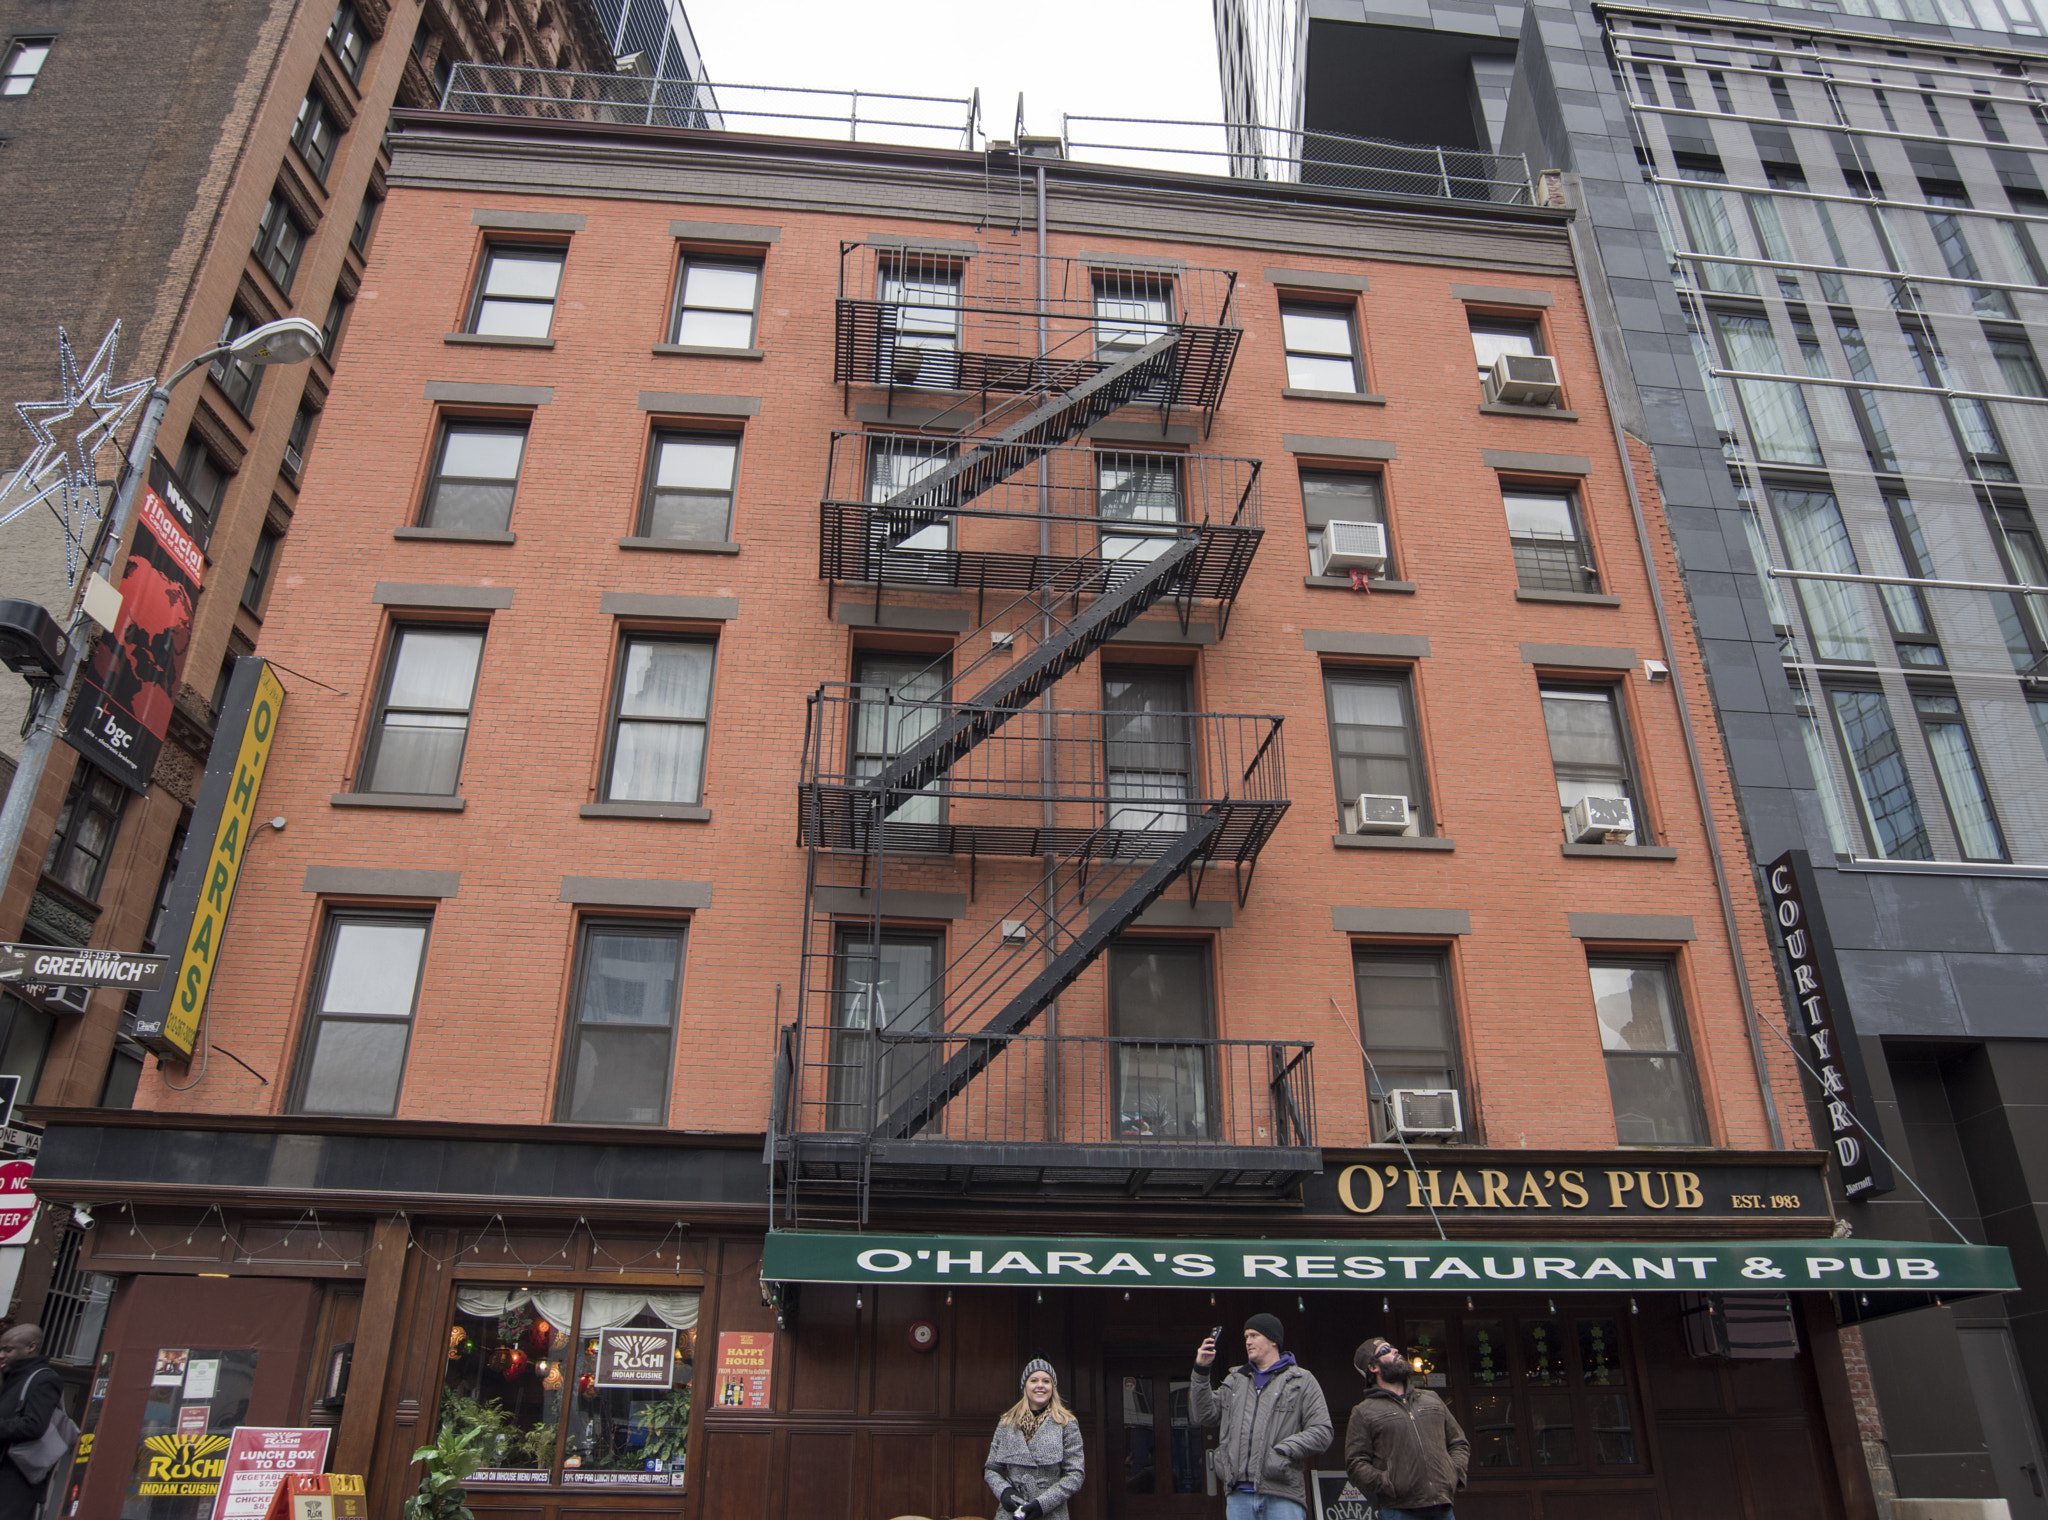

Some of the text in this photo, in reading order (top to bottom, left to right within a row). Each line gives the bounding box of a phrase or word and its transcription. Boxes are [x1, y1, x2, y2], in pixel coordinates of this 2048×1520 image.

[167, 481, 193, 524] NYC
[143, 493, 202, 570] financial
[103, 715, 133, 748] bgc
[79, 951, 111, 960] 131-139
[34, 955, 159, 982] GREENWICH ST
[1772, 865, 1861, 1167] COURTYARD
[26, 1134, 39, 1148] WA
[10, 1176, 29, 1190] NO
[1338, 1164, 1801, 1213] O'HARA'S PUB EST. 1983
[0, 1213, 21, 1226] TER
[856, 1249, 1940, 1280] O'HARA'S RESTAURANT & PUB
[727, 1348, 765, 1356] HAPPY
[611, 1371, 663, 1379] INDIAN CUISINE
[240, 1450, 316, 1460] LUNCH BOX
[256, 1460, 296, 1468] TO GO
[473, 1472, 489, 1480] LUNCH
[531, 1473, 548, 1482] PRICES
[575, 1474, 585, 1482] OFF
[594, 1474, 609, 1482] LUNCH
[652, 1475, 668, 1484] PRICES
[139, 1483, 217, 1494] INDIAN CUISIN
